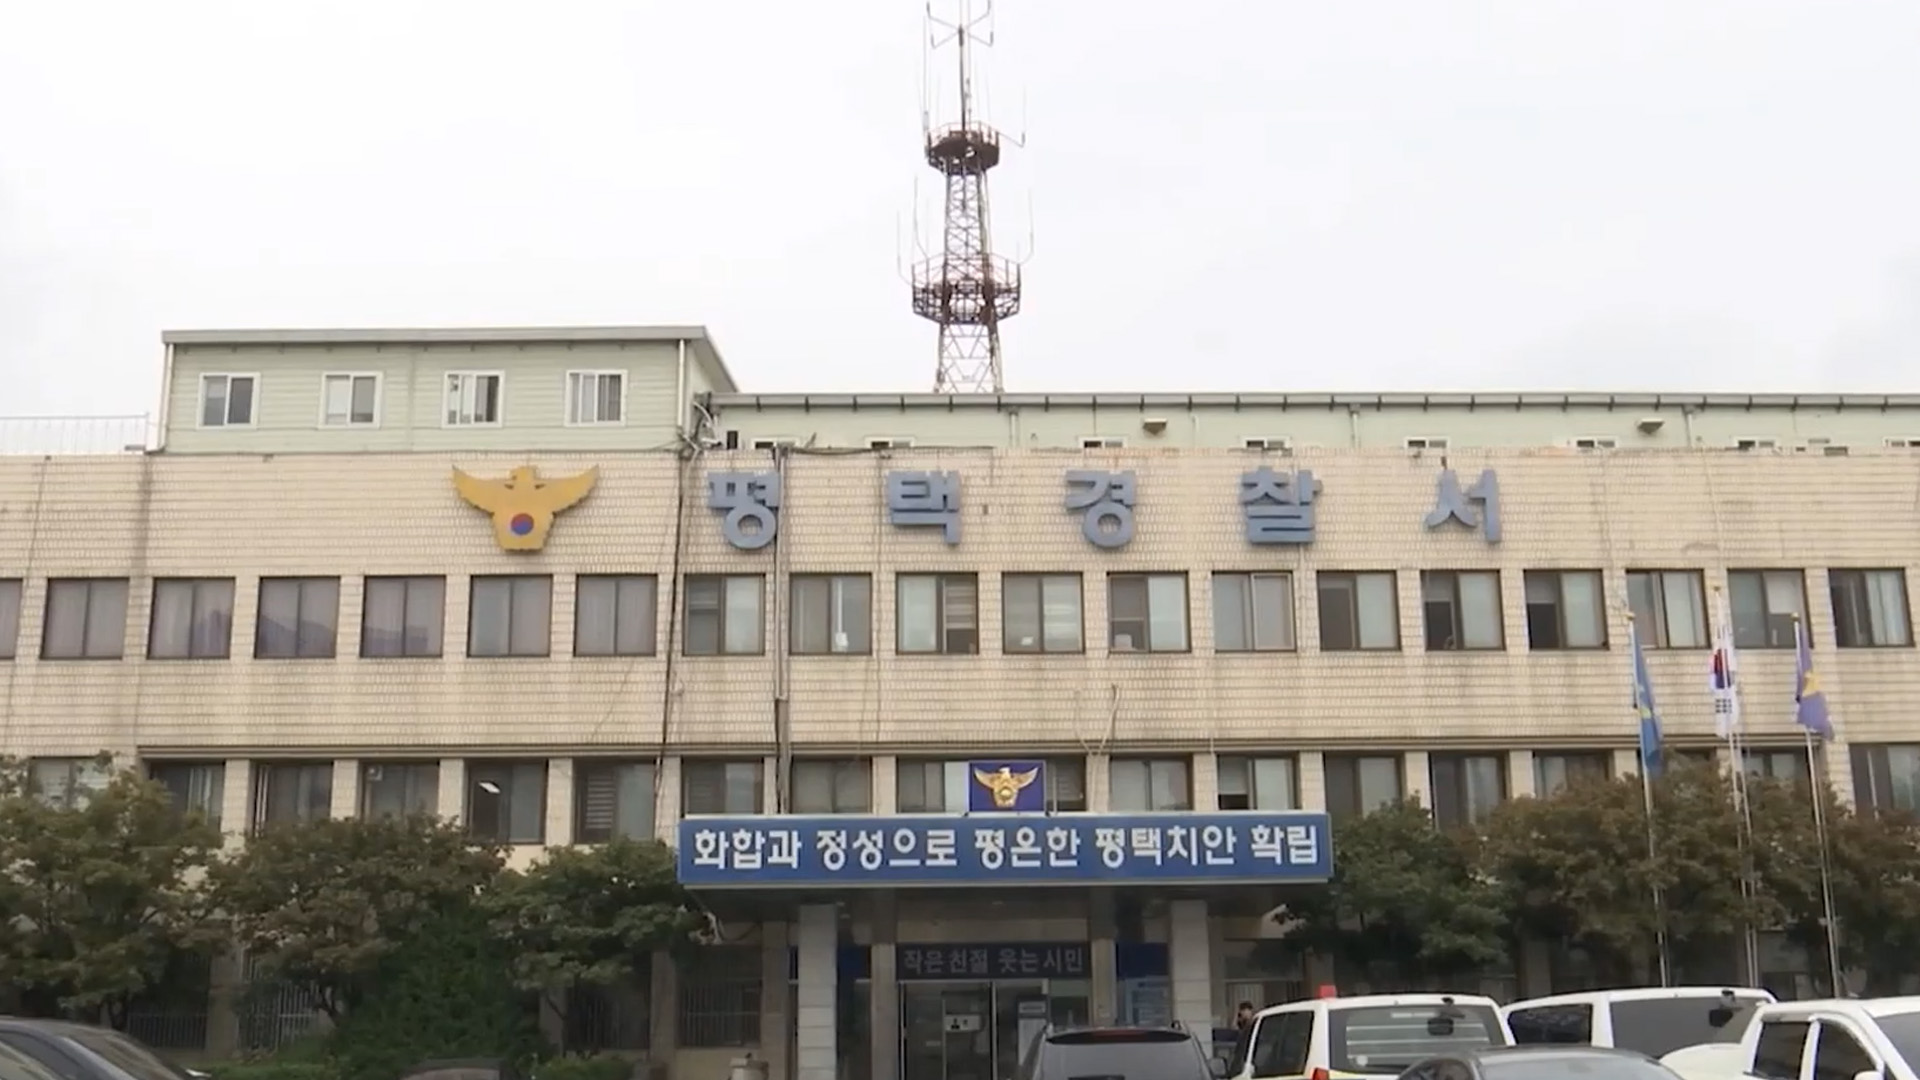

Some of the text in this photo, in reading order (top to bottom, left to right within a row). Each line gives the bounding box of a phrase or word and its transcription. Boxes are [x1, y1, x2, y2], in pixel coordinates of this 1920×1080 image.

[707, 465, 1501, 550] 평택경찰서
[694, 824, 1318, 869] 화합과 정성으로 평온한 평택치안 확립
